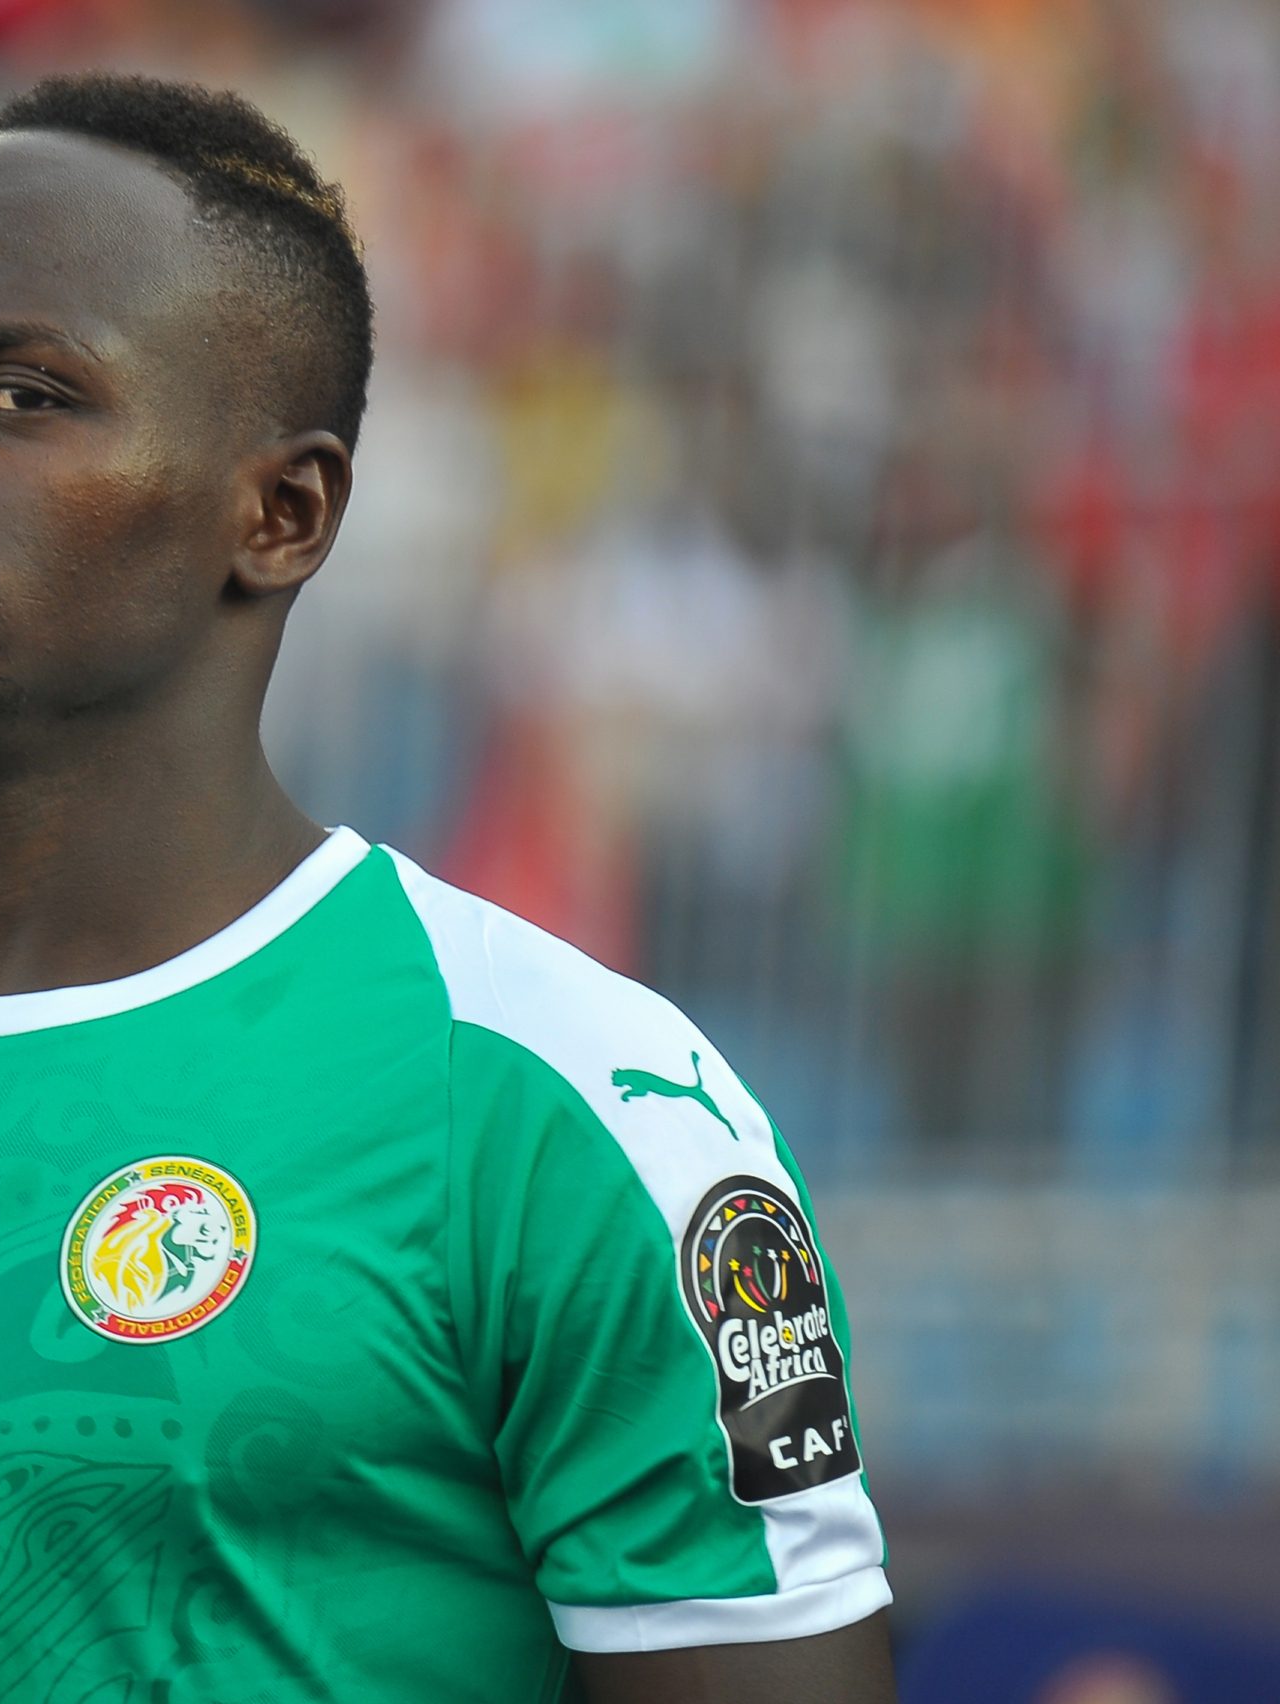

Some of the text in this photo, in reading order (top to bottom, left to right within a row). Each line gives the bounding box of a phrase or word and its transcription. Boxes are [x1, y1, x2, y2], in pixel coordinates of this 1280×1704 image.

[150, 1162, 247, 1237] SÉNÉGALAISE
[69, 1185, 119, 1302] FÉDÉRATION
[116, 1296, 217, 1335] FOOTBALL
[718, 1303, 828, 1382] Celebrate
[748, 1346, 827, 1400] Africa
[768, 1418, 844, 1470] CAF
